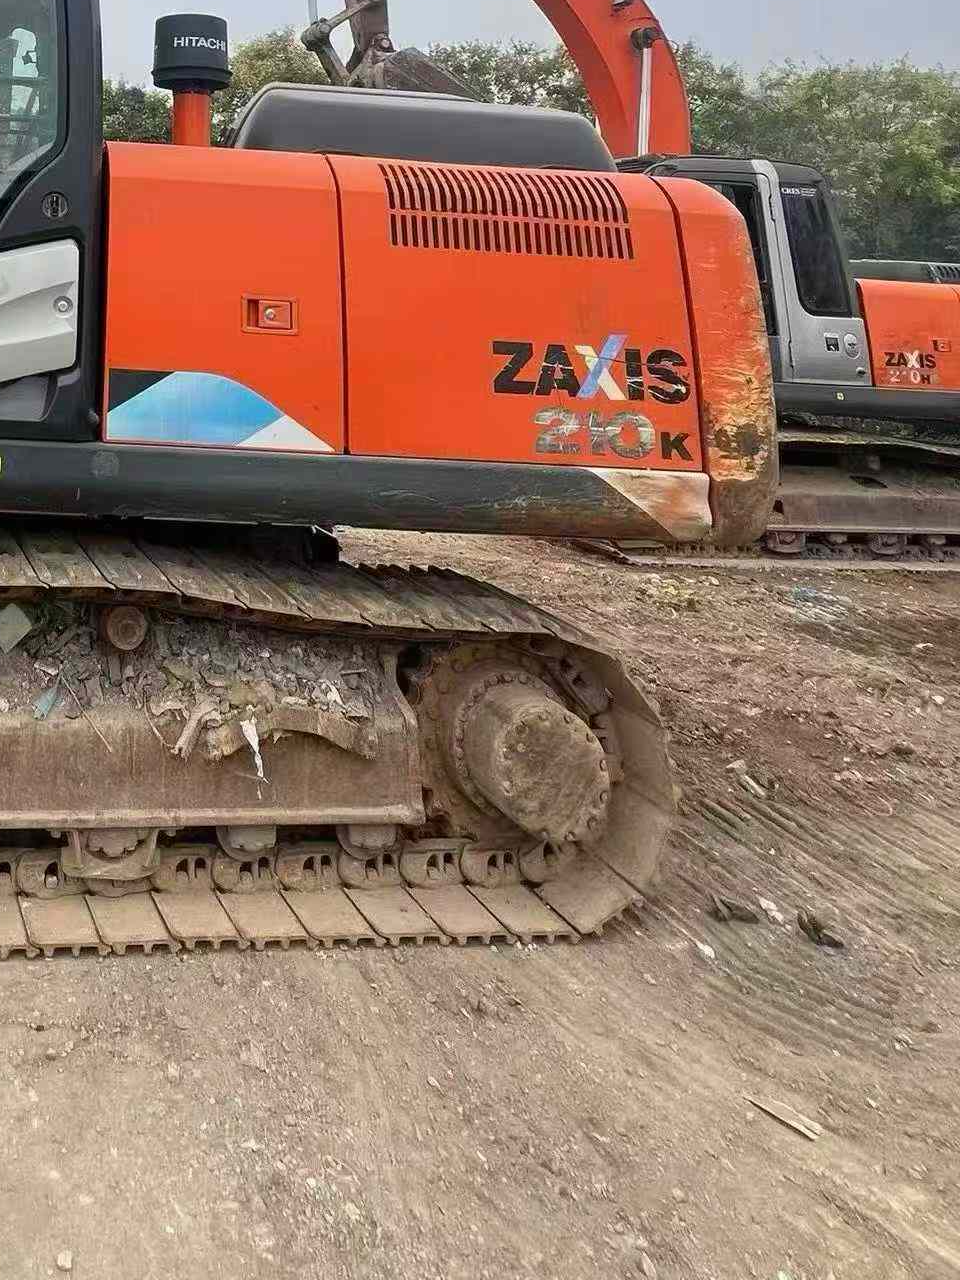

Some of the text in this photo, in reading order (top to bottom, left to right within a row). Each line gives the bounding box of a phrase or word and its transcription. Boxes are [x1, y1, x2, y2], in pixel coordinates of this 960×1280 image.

[173, 36, 226, 52] HITACHI
[493, 334, 691, 404] ZAXIS
[885, 350, 936, 369] ZAXIS
